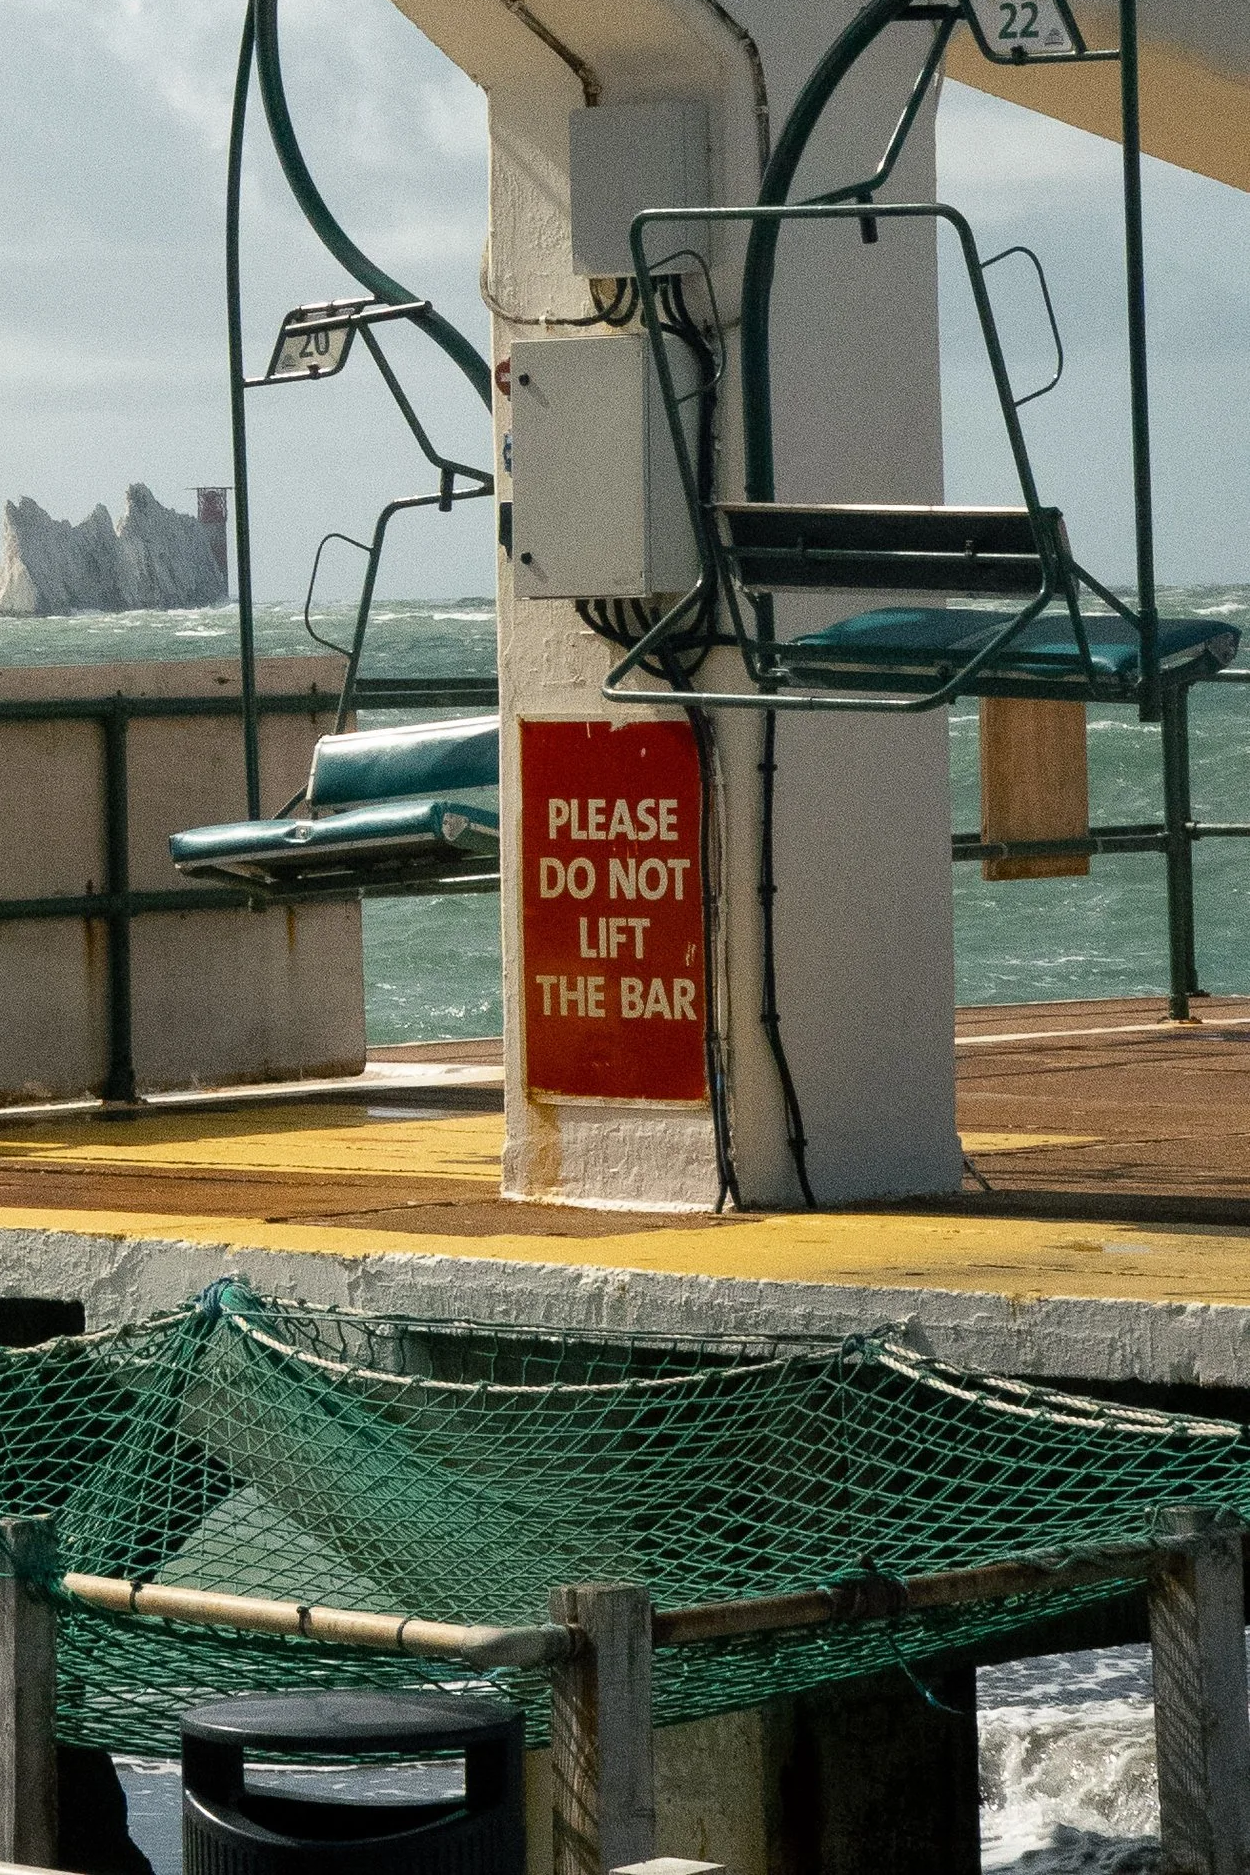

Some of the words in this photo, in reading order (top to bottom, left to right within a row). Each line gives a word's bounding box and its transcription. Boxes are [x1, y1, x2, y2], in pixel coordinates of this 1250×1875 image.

[999, 2, 1040, 39] 22
[299, 331, 330, 358] 20
[548, 798, 679, 841] PLEASE
[539, 857, 596, 899] DO
[608, 858, 691, 900] NOT
[579, 917, 650, 959] LIFT
[536, 975, 606, 1017] THE
[620, 977, 698, 1020] BAR
